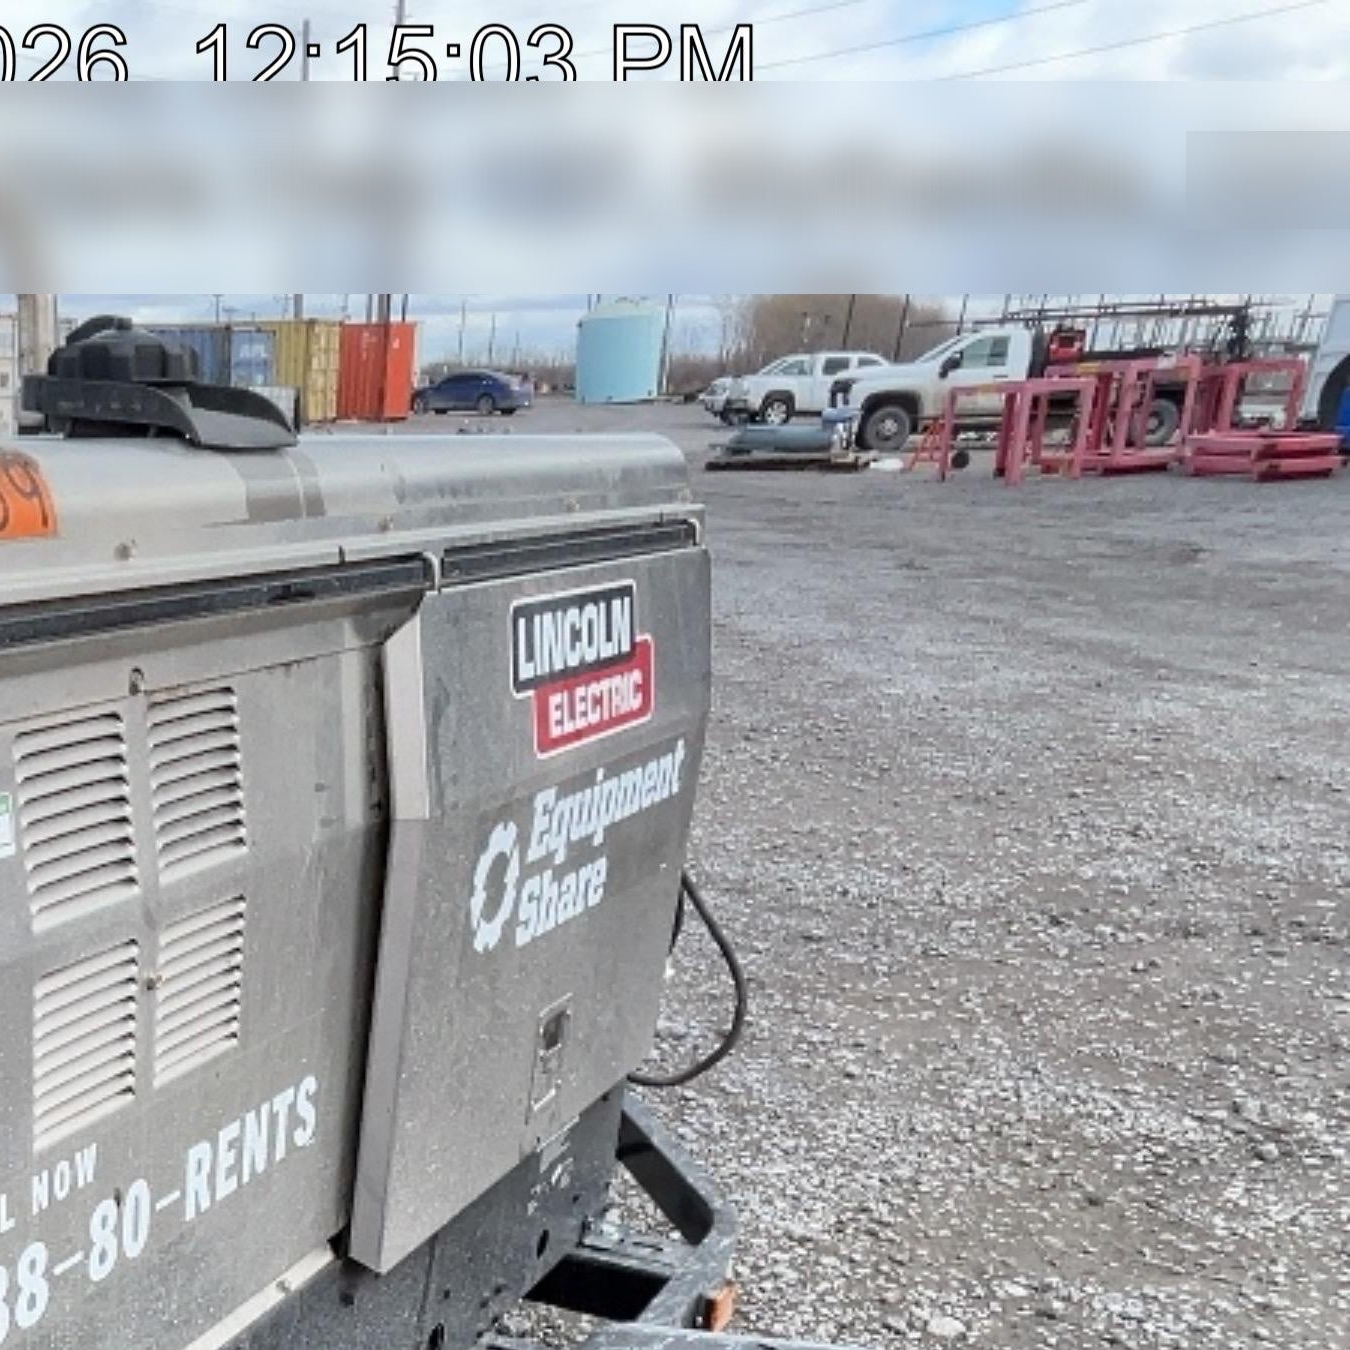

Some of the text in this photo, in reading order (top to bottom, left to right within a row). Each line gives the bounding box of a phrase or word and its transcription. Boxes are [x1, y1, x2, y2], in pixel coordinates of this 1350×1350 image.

[516, 596, 631, 681] LINCOLN
[547, 667, 645, 739] ELECTRIC
[527, 738, 684, 868] Equipment
[516, 853, 607, 948] Share
[32, 1143, 99, 1213] NOW
